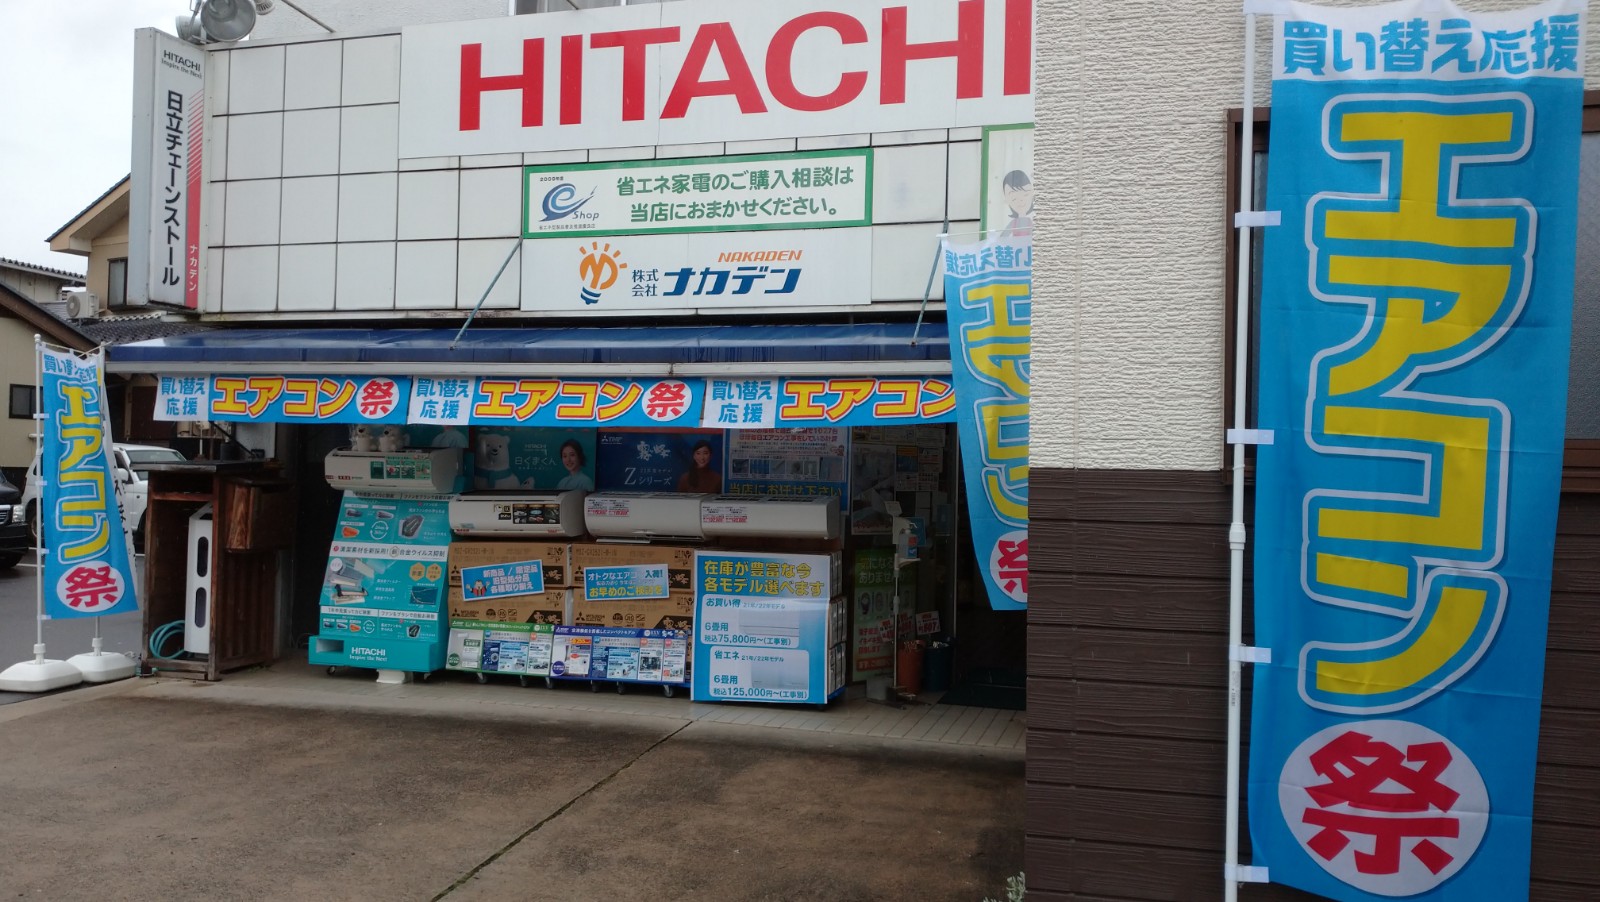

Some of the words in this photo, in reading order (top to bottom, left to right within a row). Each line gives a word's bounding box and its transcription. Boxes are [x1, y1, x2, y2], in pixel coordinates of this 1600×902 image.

[1283, 13, 1581, 76] 買い替え応援
[163, 49, 201, 72] HITACHI
[459, 0, 1032, 131] HITACHI
[162, 90, 184, 286] 日立チェーンストール
[616, 166, 854, 196] 省エネ家電のご購入相談は
[630, 196, 838, 223] 当店におまかせください。
[717, 249, 803, 263] NAKADEN
[188, 244, 198, 292] ナカデン
[662, 266, 803, 296] ナカデン
[160, 376, 207, 396] 買い替え
[416, 377, 469, 398] 買い替え
[712, 379, 773, 401] 買い替え
[165, 397, 198, 416] 応援
[419, 399, 459, 419] 応援
[779, 378, 956, 422] エアコン
[718, 402, 763, 424] 応援
[514, 456, 557, 466] 白くまくん
[638, 476, 673, 486] シリーズ
[704, 559, 812, 579] 在庫が豊富な今
[704, 577, 825, 597] 各モデル選べます
[706, 597, 741, 608] お買い得
[704, 622, 729, 632] 6畳用
[351, 647, 386, 656] HITACHI
[714, 651, 740, 660] 省エネ
[713, 675, 738, 685] 6畳用
